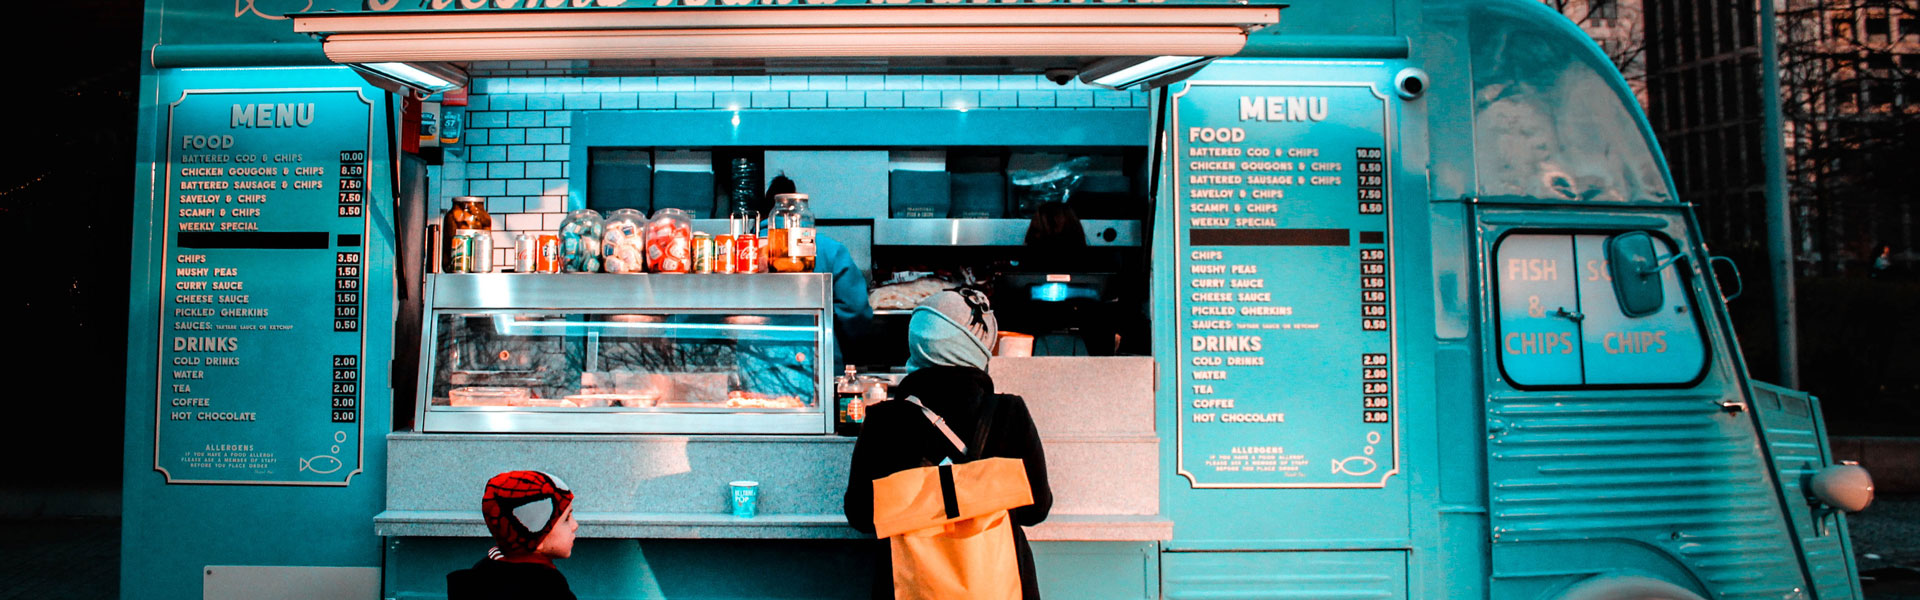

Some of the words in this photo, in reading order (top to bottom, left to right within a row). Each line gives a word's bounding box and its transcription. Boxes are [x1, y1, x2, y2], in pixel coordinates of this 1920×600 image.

[1240, 95, 1328, 121] MENU
[231, 102, 315, 127] MENU
[1189, 127, 1246, 143] FOOD
[182, 134, 235, 149] FOOD
[340, 152, 363, 161] 10.00
[1189, 147, 1243, 157] BATTERED
[1246, 147, 1271, 157] COD
[1275, 148, 1283, 157] &
[1288, 148, 1319, 157] CHIPS
[1357, 149, 1381, 159] 10.00
[182, 154, 230, 163] BATTERED
[235, 154, 257, 162] COD
[262, 153, 268, 162] &
[274, 153, 303, 162] CHIPS
[181, 167, 224, 176] CHICKEN
[228, 167, 278, 176] GOUGONS
[283, 167, 290, 175] &
[295, 166, 324, 176] CHIPS
[341, 166, 362, 175] 8.50
[1190, 161, 1237, 171] CHICKEN
[1240, 161, 1294, 171] GOUGONS
[1298, 162, 1306, 171] &
[1311, 162, 1342, 171] CHIPS
[1360, 163, 1382, 172] 8.50
[180, 180, 229, 190] BATTERED
[233, 180, 277, 189] SAUSAGE
[281, 180, 289, 189] &
[293, 180, 323, 189] CHIPS
[340, 179, 361, 189] 7.50
[1190, 175, 1243, 185] BATTERED
[1247, 175, 1293, 185] SAUSAGE
[1298, 176, 1306, 185] &
[1310, 176, 1342, 185] CHIPS
[1359, 176, 1382, 185] 7.50
[180, 194, 221, 204] SAVELOY
[225, 194, 233, 203] &
[237, 194, 267, 203] CHIPS
[340, 193, 361, 202] 7.50
[1190, 189, 1235, 199] SAVELOY
[1239, 189, 1247, 198] &
[1252, 189, 1284, 199] CHIPS
[1359, 190, 1382, 199] 7.50
[179, 208, 215, 217] SCAMPI
[219, 208, 226, 217] &
[231, 208, 261, 217] CHIPS
[339, 206, 360, 216] 8.50
[1190, 203, 1229, 212] SCAMPI
[1233, 203, 1242, 213] &
[1246, 203, 1278, 213] CHIPS
[1360, 203, 1383, 213] 8.50
[179, 222, 216, 231] WEEKLY
[220, 222, 259, 231] SPECIAL
[1191, 217, 1230, 227] WEEKLY
[1235, 217, 1277, 227] SPECIAL
[177, 254, 206, 263] CHIPS
[337, 253, 359, 263] 3.50
[1191, 250, 1223, 260] CHIPS
[1362, 250, 1384, 260] 3.50
[176, 267, 209, 277] MUSHY
[214, 267, 238, 277] PEAS
[337, 267, 357, 276] 1.50
[1191, 264, 1227, 274] MUSHY
[1231, 264, 1258, 274] PEAS
[1363, 264, 1384, 274] 1.50
[1508, 258, 1558, 281] FISH
[176, 281, 208, 290] CURRY
[212, 281, 243, 290] SAUCE
[337, 280, 357, 289] 1.50
[1191, 278, 1226, 288] CURRY
[1230, 278, 1264, 288] SAUCE
[1364, 278, 1384, 288] 1.50
[175, 294, 214, 303] CHEESE
[218, 294, 249, 304] SAUCE
[337, 293, 356, 303] 1.50
[1191, 292, 1233, 302] CHEESE
[1238, 292, 1271, 302] SAUCE
[1364, 292, 1385, 302] 1.50
[336, 307, 356, 316] 1.00
[1192, 306, 1236, 316] PICKLED
[1241, 306, 1293, 316] GHERKINS
[1364, 306, 1385, 316] 1.00
[1528, 295, 1546, 318] &
[175, 308, 216, 317] PICKLED
[220, 308, 269, 317] GHERKINS
[175, 321, 213, 330] SAUCES:
[335, 320, 356, 330] 0.50
[1364, 319, 1387, 330] 0.50
[174, 336, 238, 352] DRINKS
[1192, 336, 1262, 352] DRINKS
[1504, 332, 1573, 355] CHIPS
[1603, 331, 1668, 354] CHIPS
[173, 356, 201, 365] COLD
[205, 357, 240, 366] DRINKS
[334, 357, 355, 367] 2.00
[1192, 356, 1223, 366] COLD
[1227, 356, 1265, 366] DRINKS
[1364, 355, 1387, 365] 2.00
[173, 370, 204, 379] WATER
[334, 370, 356, 380] 2.00
[1193, 370, 1227, 380] WATER
[1364, 369, 1387, 379] 2.00
[172, 384, 191, 393] TEA
[333, 384, 355, 393] 2.00
[1193, 385, 1214, 394] TEA
[1365, 383, 1388, 394] 2.00
[172, 398, 210, 407] COFFEE
[333, 398, 354, 407] 3.00
[1193, 399, 1235, 409] COFFEE
[1365, 398, 1388, 408] 3.00
[171, 411, 192, 420] HOT
[197, 411, 257, 421] CHOCOLATE
[333, 412, 354, 421] 3.00
[1193, 413, 1216, 423] HOT
[1221, 413, 1285, 423] CHOCOLATE
[1365, 412, 1388, 422] 3.00
[205, 444, 254, 452] ALLERGENS
